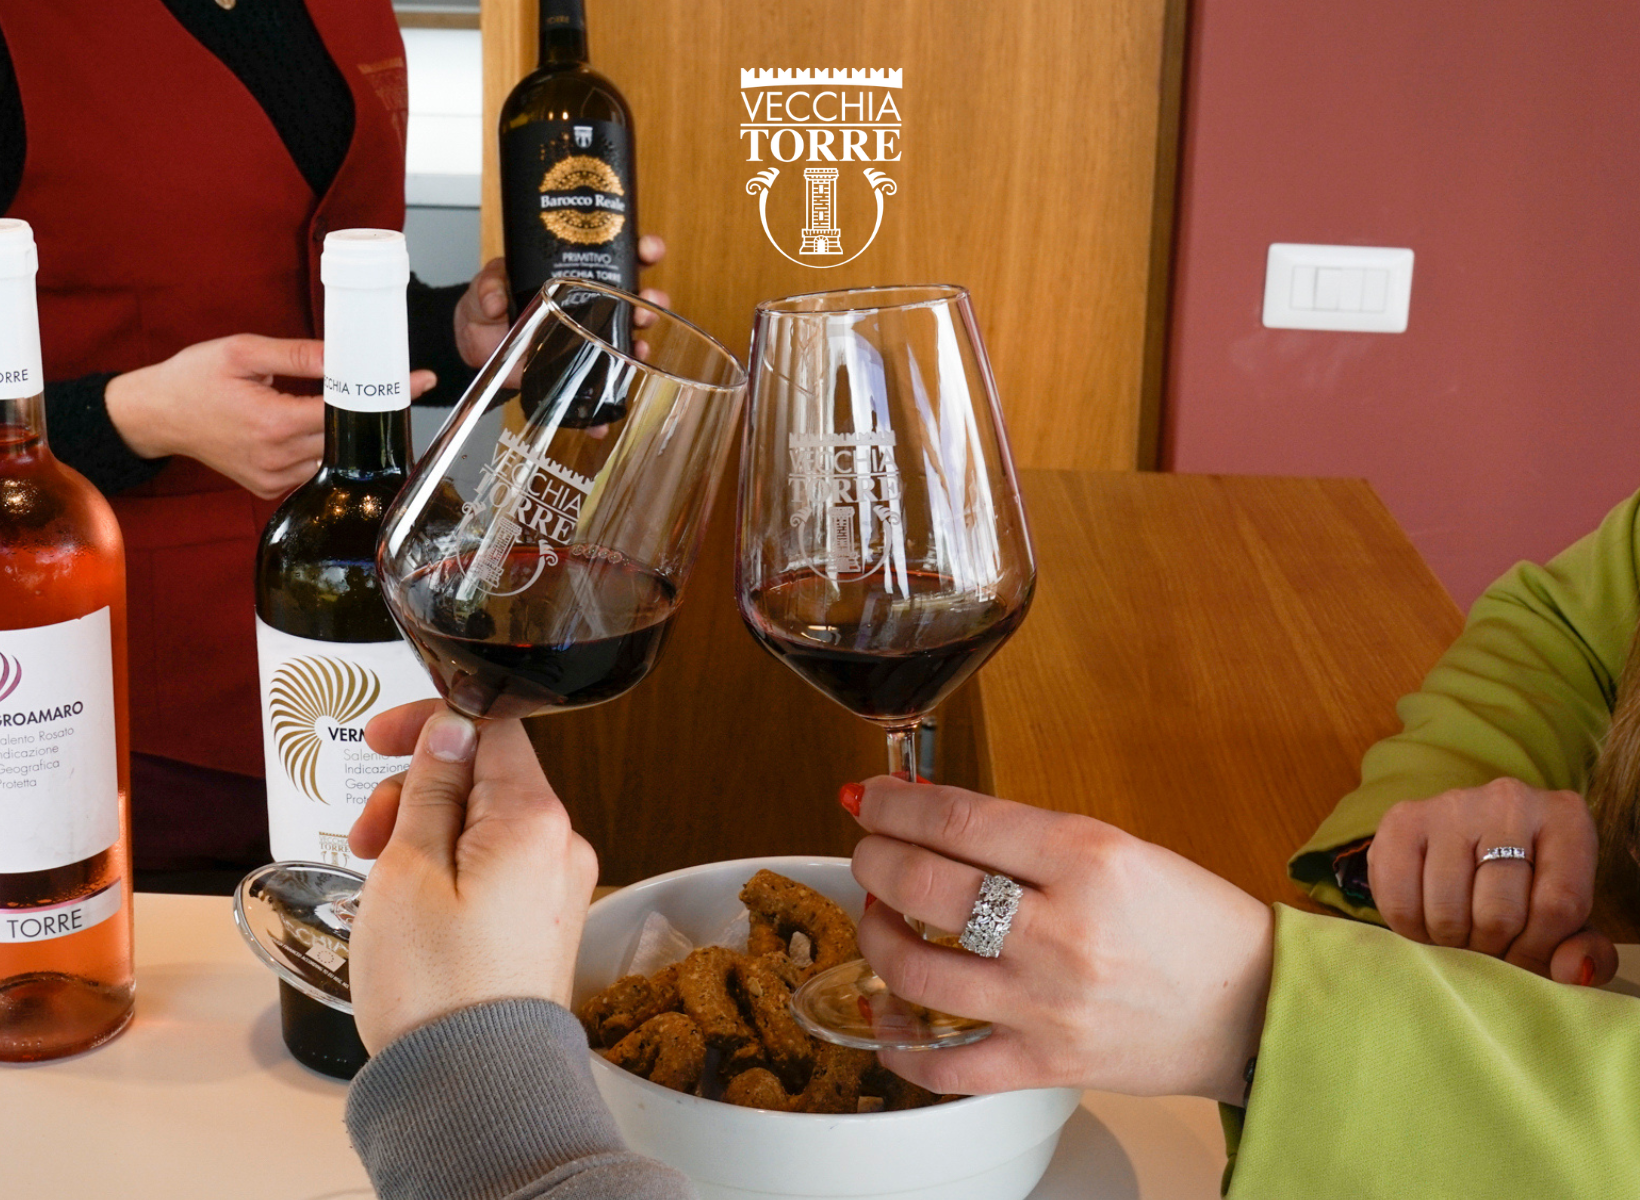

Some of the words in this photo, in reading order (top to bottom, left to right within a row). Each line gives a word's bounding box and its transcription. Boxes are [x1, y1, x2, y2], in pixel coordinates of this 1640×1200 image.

[540, 194, 593, 209] Barocco
[594, 193, 625, 212] Reale
[562, 252, 612, 264] PRIMITIVO
[551, 270, 595, 280] VECCHIA
[355, 382, 401, 397] TORRE
[789, 448, 899, 474] VECCHIA
[490, 442, 582, 519] VECCHIA
[788, 475, 902, 504] TORRE
[473, 467, 577, 545] TORRE
[0, 701, 83, 727] ROAMARO
[38, 727, 75, 742] Rosato
[344, 763, 410, 775] Indicazione
[0, 779, 37, 789] rotetta
[319, 843, 350, 853] TORRE
[6, 908, 83, 939] TORRE
